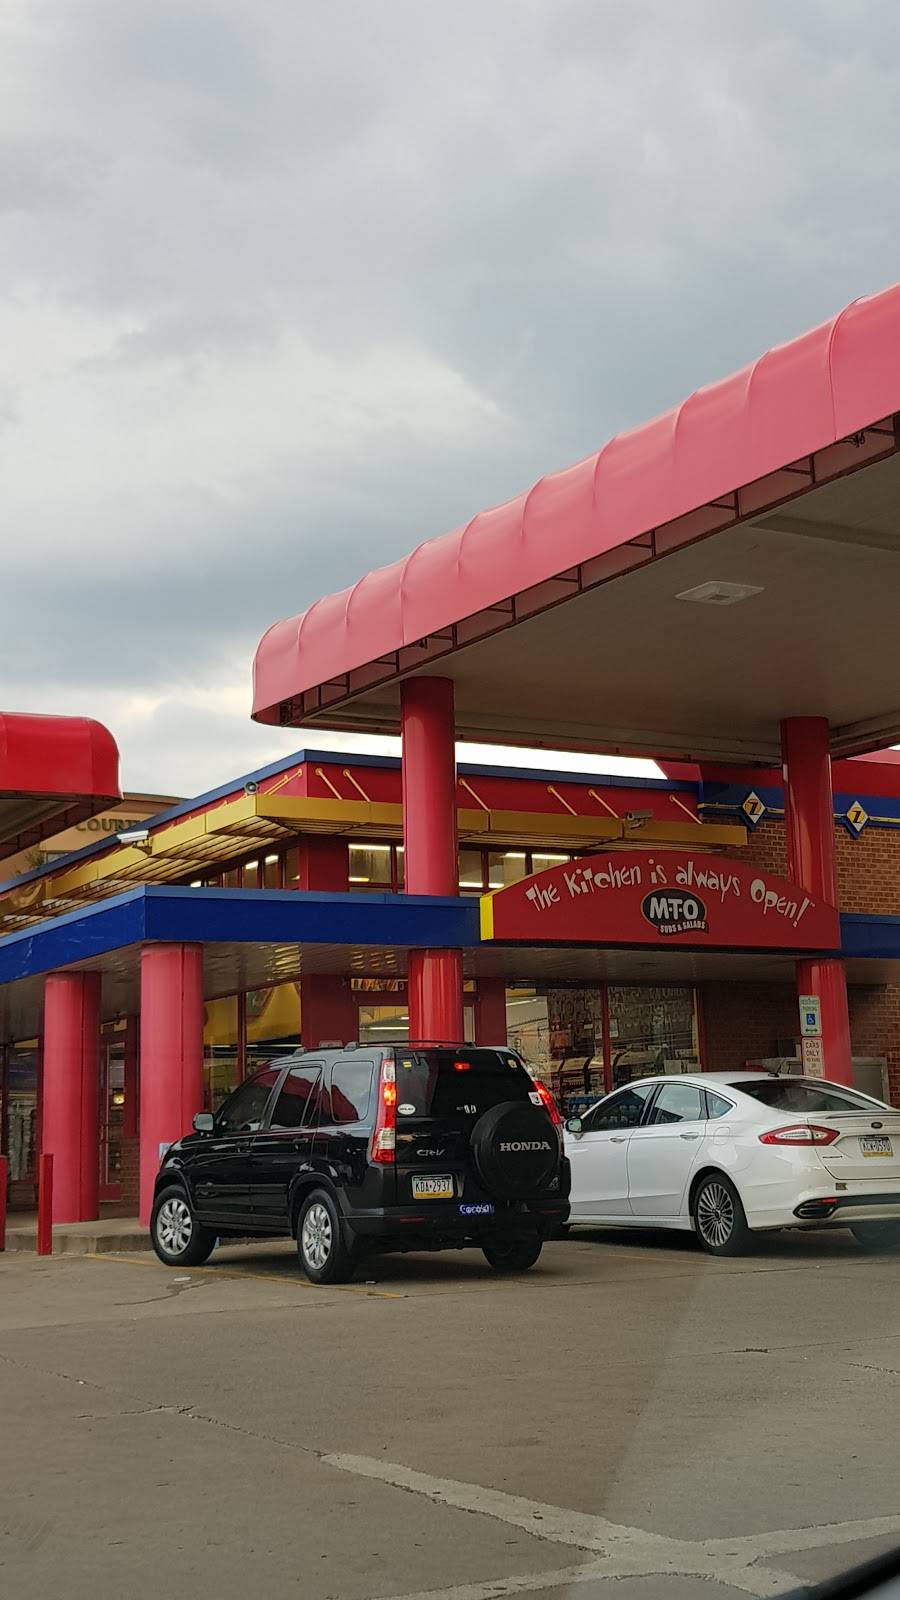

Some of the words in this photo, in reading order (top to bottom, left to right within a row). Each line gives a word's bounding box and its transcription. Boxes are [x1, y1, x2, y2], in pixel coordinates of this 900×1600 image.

[525, 883, 561, 912] The
[648, 858, 668, 884] is
[675, 861, 741, 903] always
[750, 878, 809, 928] Open!
[660, 923, 677, 933] SUBS
[682, 920, 706, 930] SALADS
[805, 1041, 820, 1049] CARS
[805, 1049, 820, 1057] ONLY
[499, 1142, 552, 1152] HONDA
[416, 1149, 446, 1157] CR-V
